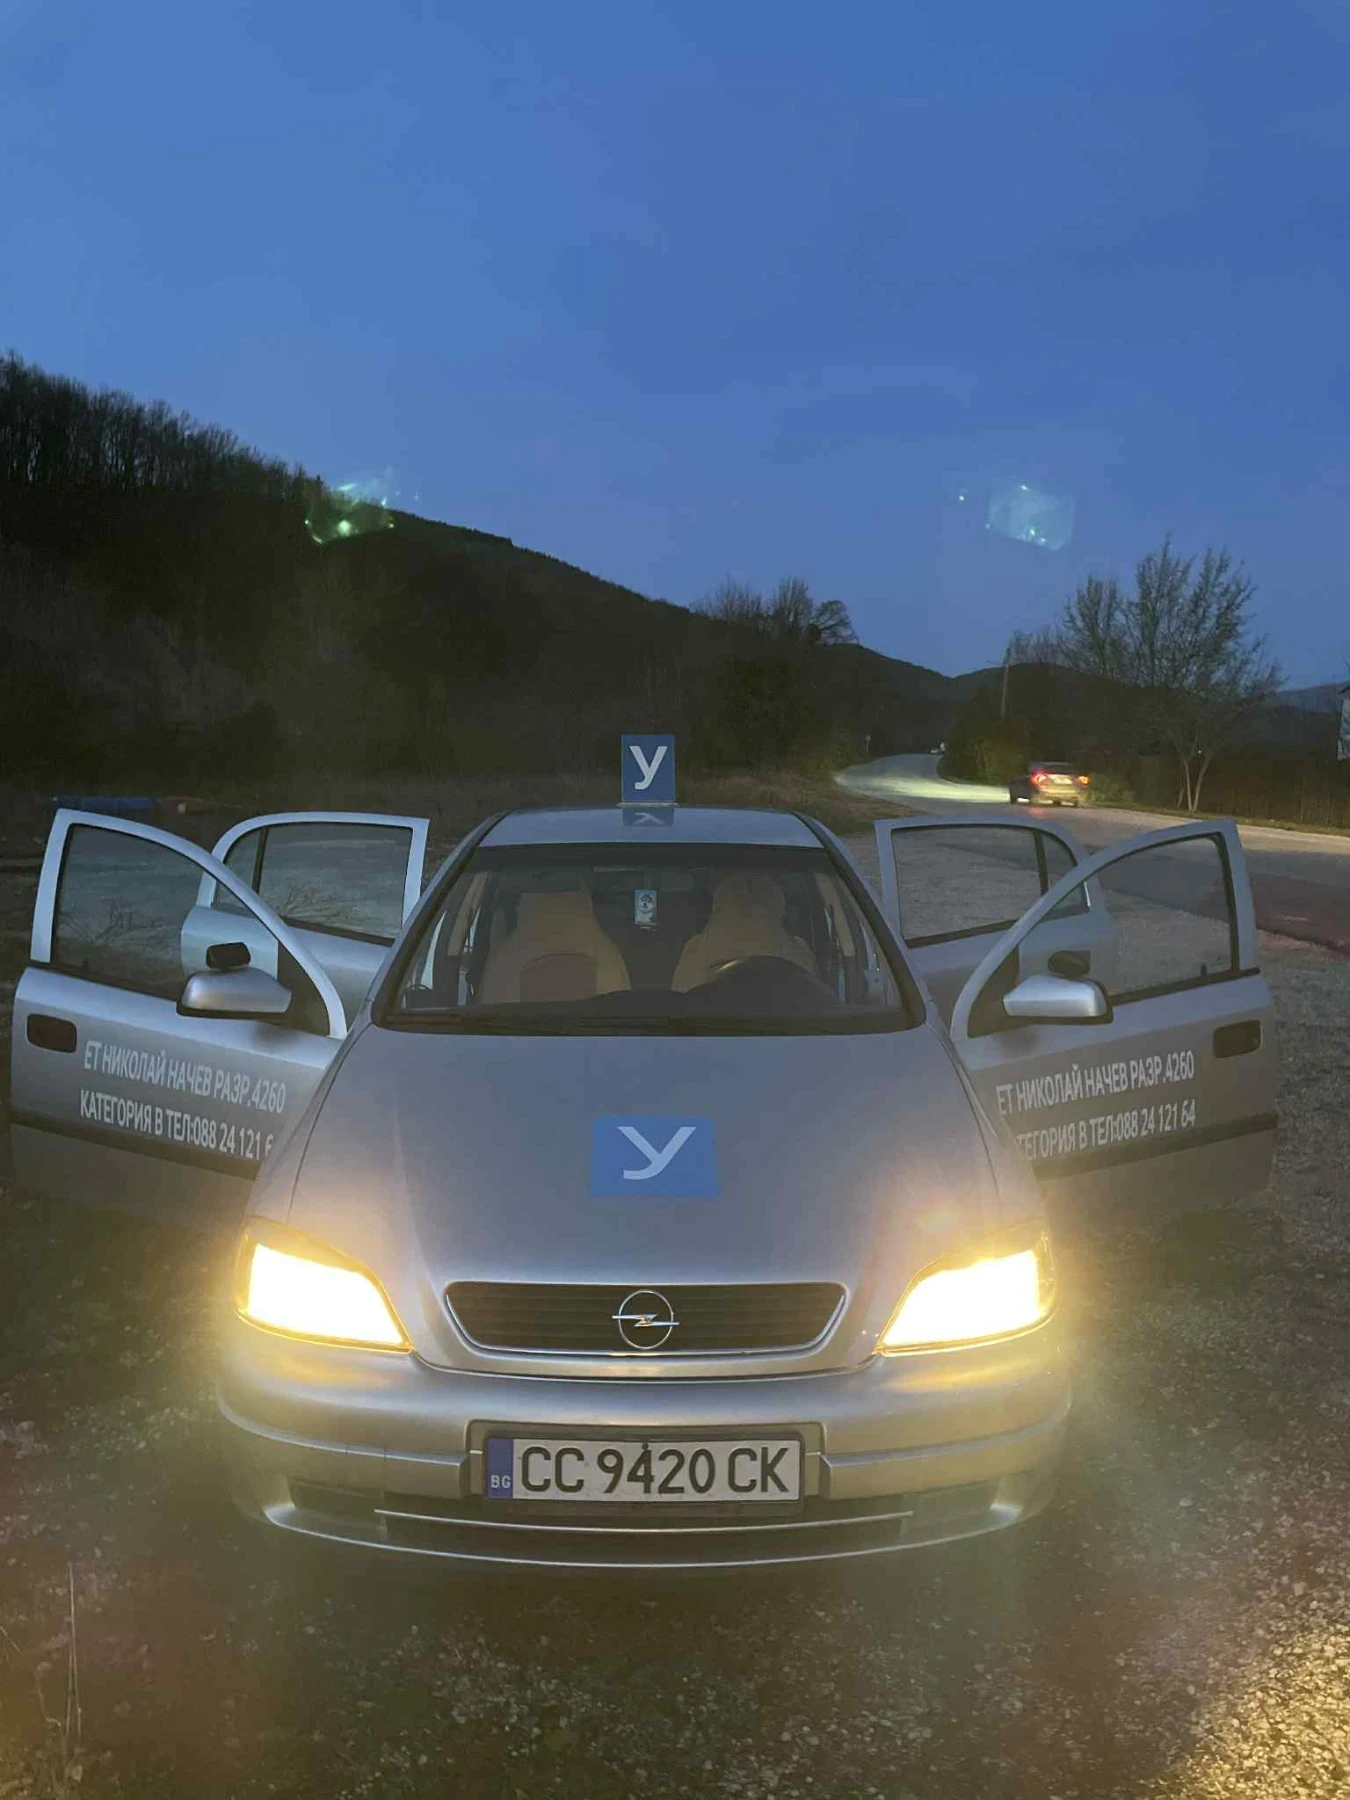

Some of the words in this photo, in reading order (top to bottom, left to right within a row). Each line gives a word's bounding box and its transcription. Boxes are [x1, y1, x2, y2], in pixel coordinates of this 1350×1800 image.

[84, 1040, 103, 1069] ЕТ
[103, 1042, 166, 1085] НИКОЛАЙ
[167, 1060, 212, 1097] НАЧЕВ
[996, 1084, 1013, 1116] ЕТ
[1015, 1064, 1083, 1111] НИКОЛАЙ
[1084, 1062, 1127, 1097] НАЧЕВ
[80, 1089, 152, 1133] КАТЕГОРИЯ
[154, 1108, 164, 1136] В
[219, 1123, 235, 1154] 24
[240, 1127, 260, 1160] 121
[1078, 1122, 1087, 1148] В
[1140, 1107, 1155, 1137] 24
[1158, 1103, 1178, 1133] 121
[1180, 1099, 1196, 1128] 64
[616, 1126, 697, 1180] У
[491, 1475, 511, 1489] BG
[521, 1446, 585, 1493] CC
[597, 1448, 716, 1495] 9420
[728, 1446, 790, 1494] CK
